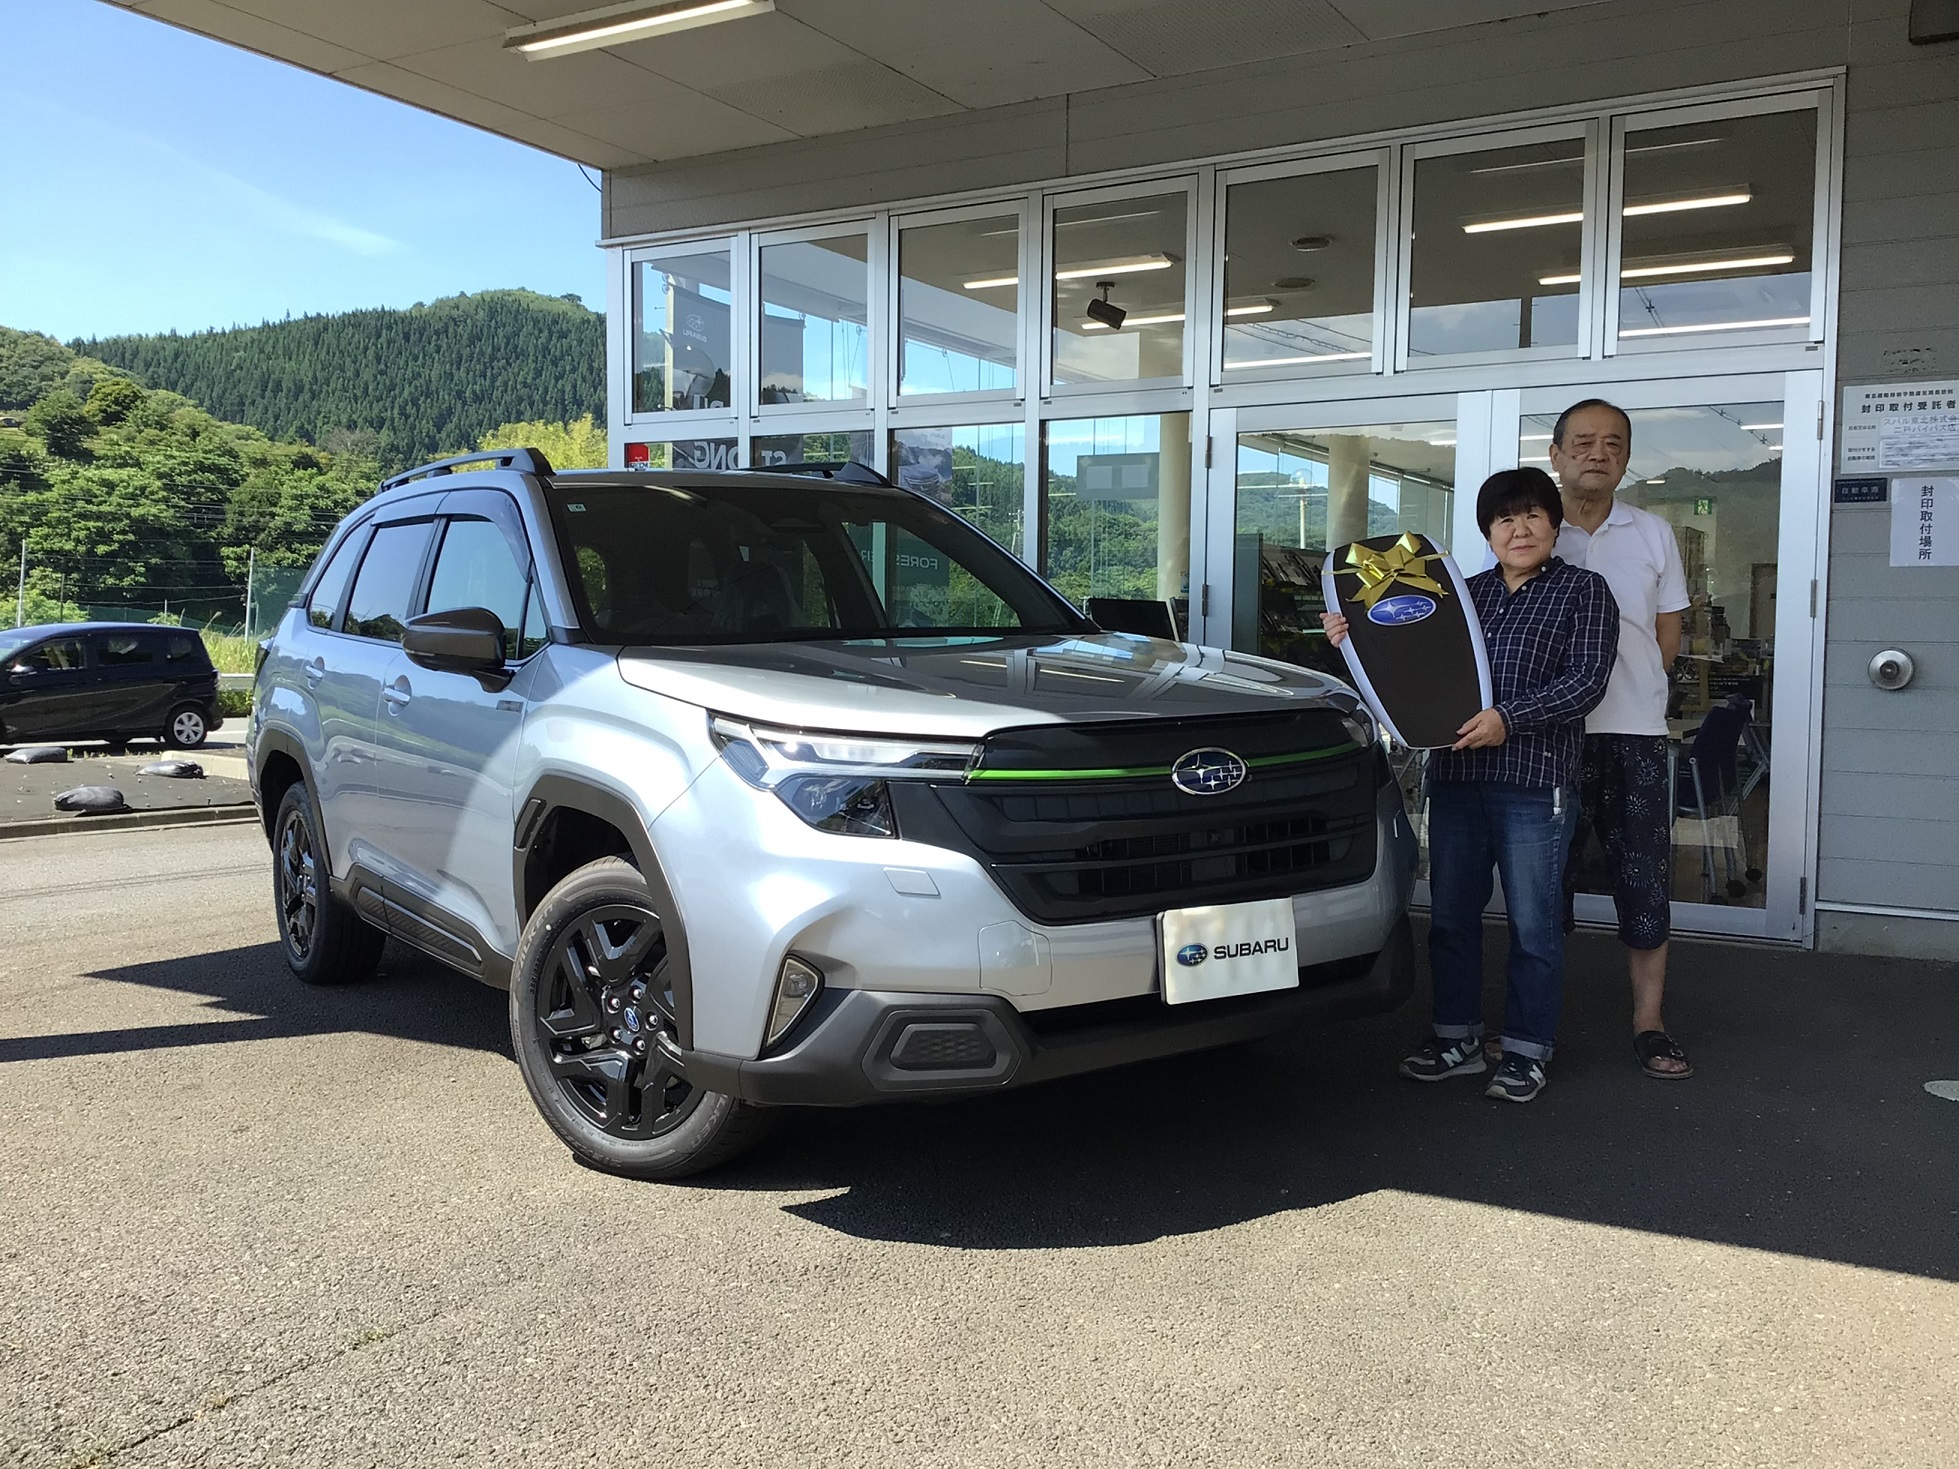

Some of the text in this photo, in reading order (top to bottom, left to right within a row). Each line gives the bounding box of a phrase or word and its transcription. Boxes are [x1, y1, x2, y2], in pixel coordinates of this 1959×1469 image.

[1860, 400, 1957, 414] 封印取付受託者
[1884, 415, 1959, 426] スバル東北株式会
[1918, 485, 1934, 560] 封印取付場所
[1213, 937, 1290, 960] SUBARU
